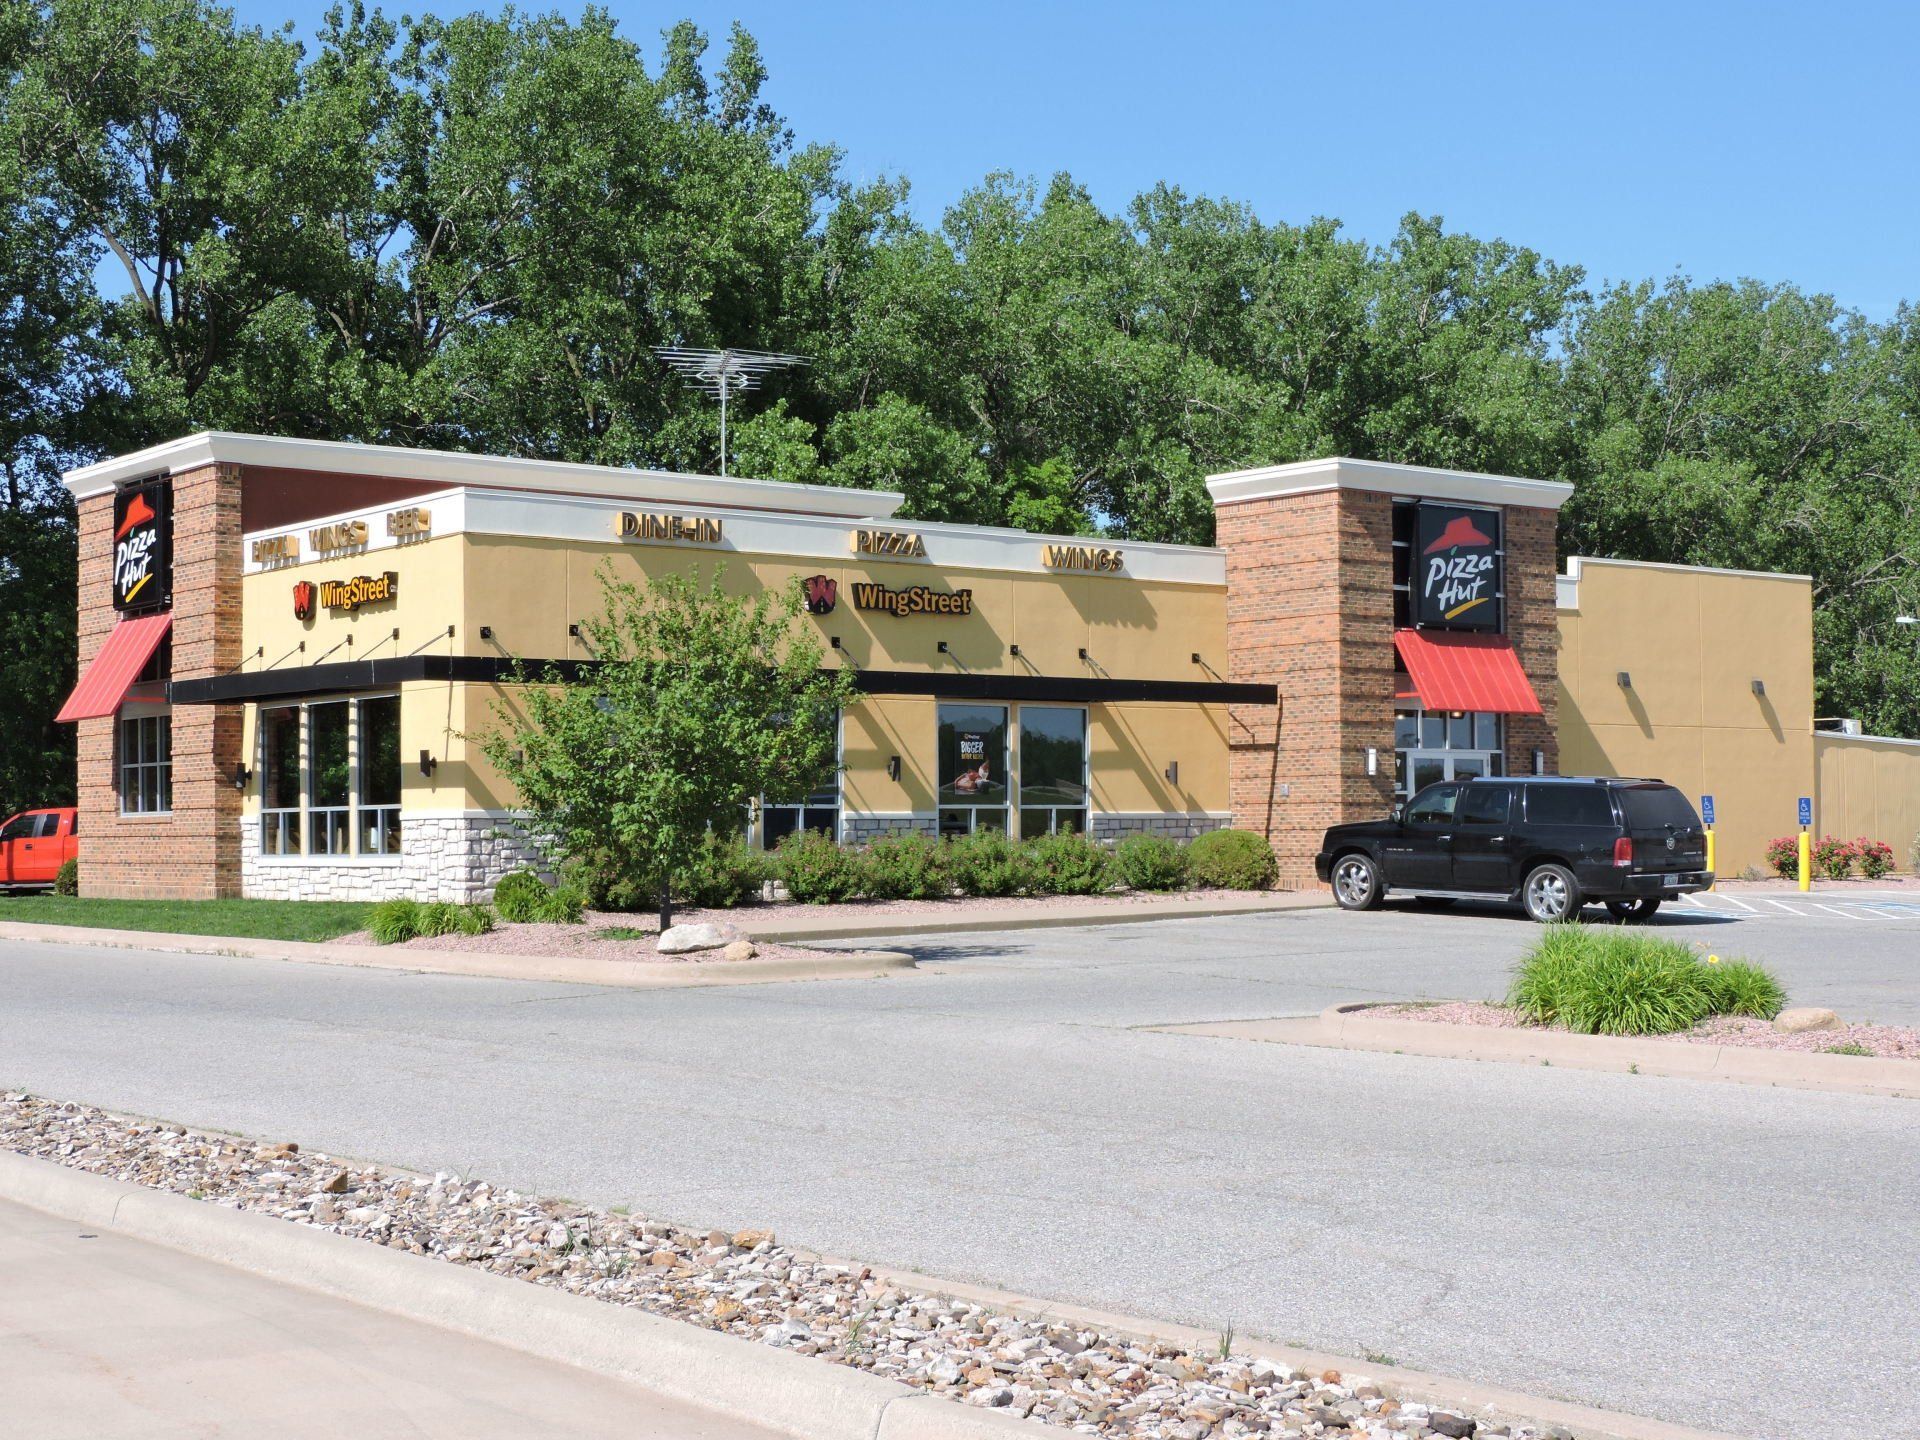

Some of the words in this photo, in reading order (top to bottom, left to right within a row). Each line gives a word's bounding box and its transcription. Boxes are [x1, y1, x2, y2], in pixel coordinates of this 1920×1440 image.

[252, 535, 299, 562] PIZZA
[309, 520, 369, 551] WINGS
[387, 507, 431, 536] BEER
[618, 511, 723, 542] DINE-IN
[851, 530, 927, 557] PIZZA
[115, 526, 157, 585] Pizza
[1043, 544, 1124, 572] WINGS
[1425, 546, 1494, 598] Pizza
[121, 552, 152, 596] Hut
[320, 574, 389, 610] WingStreet
[857, 583, 971, 616] WingStreet
[1437, 576, 1487, 611] Hut
